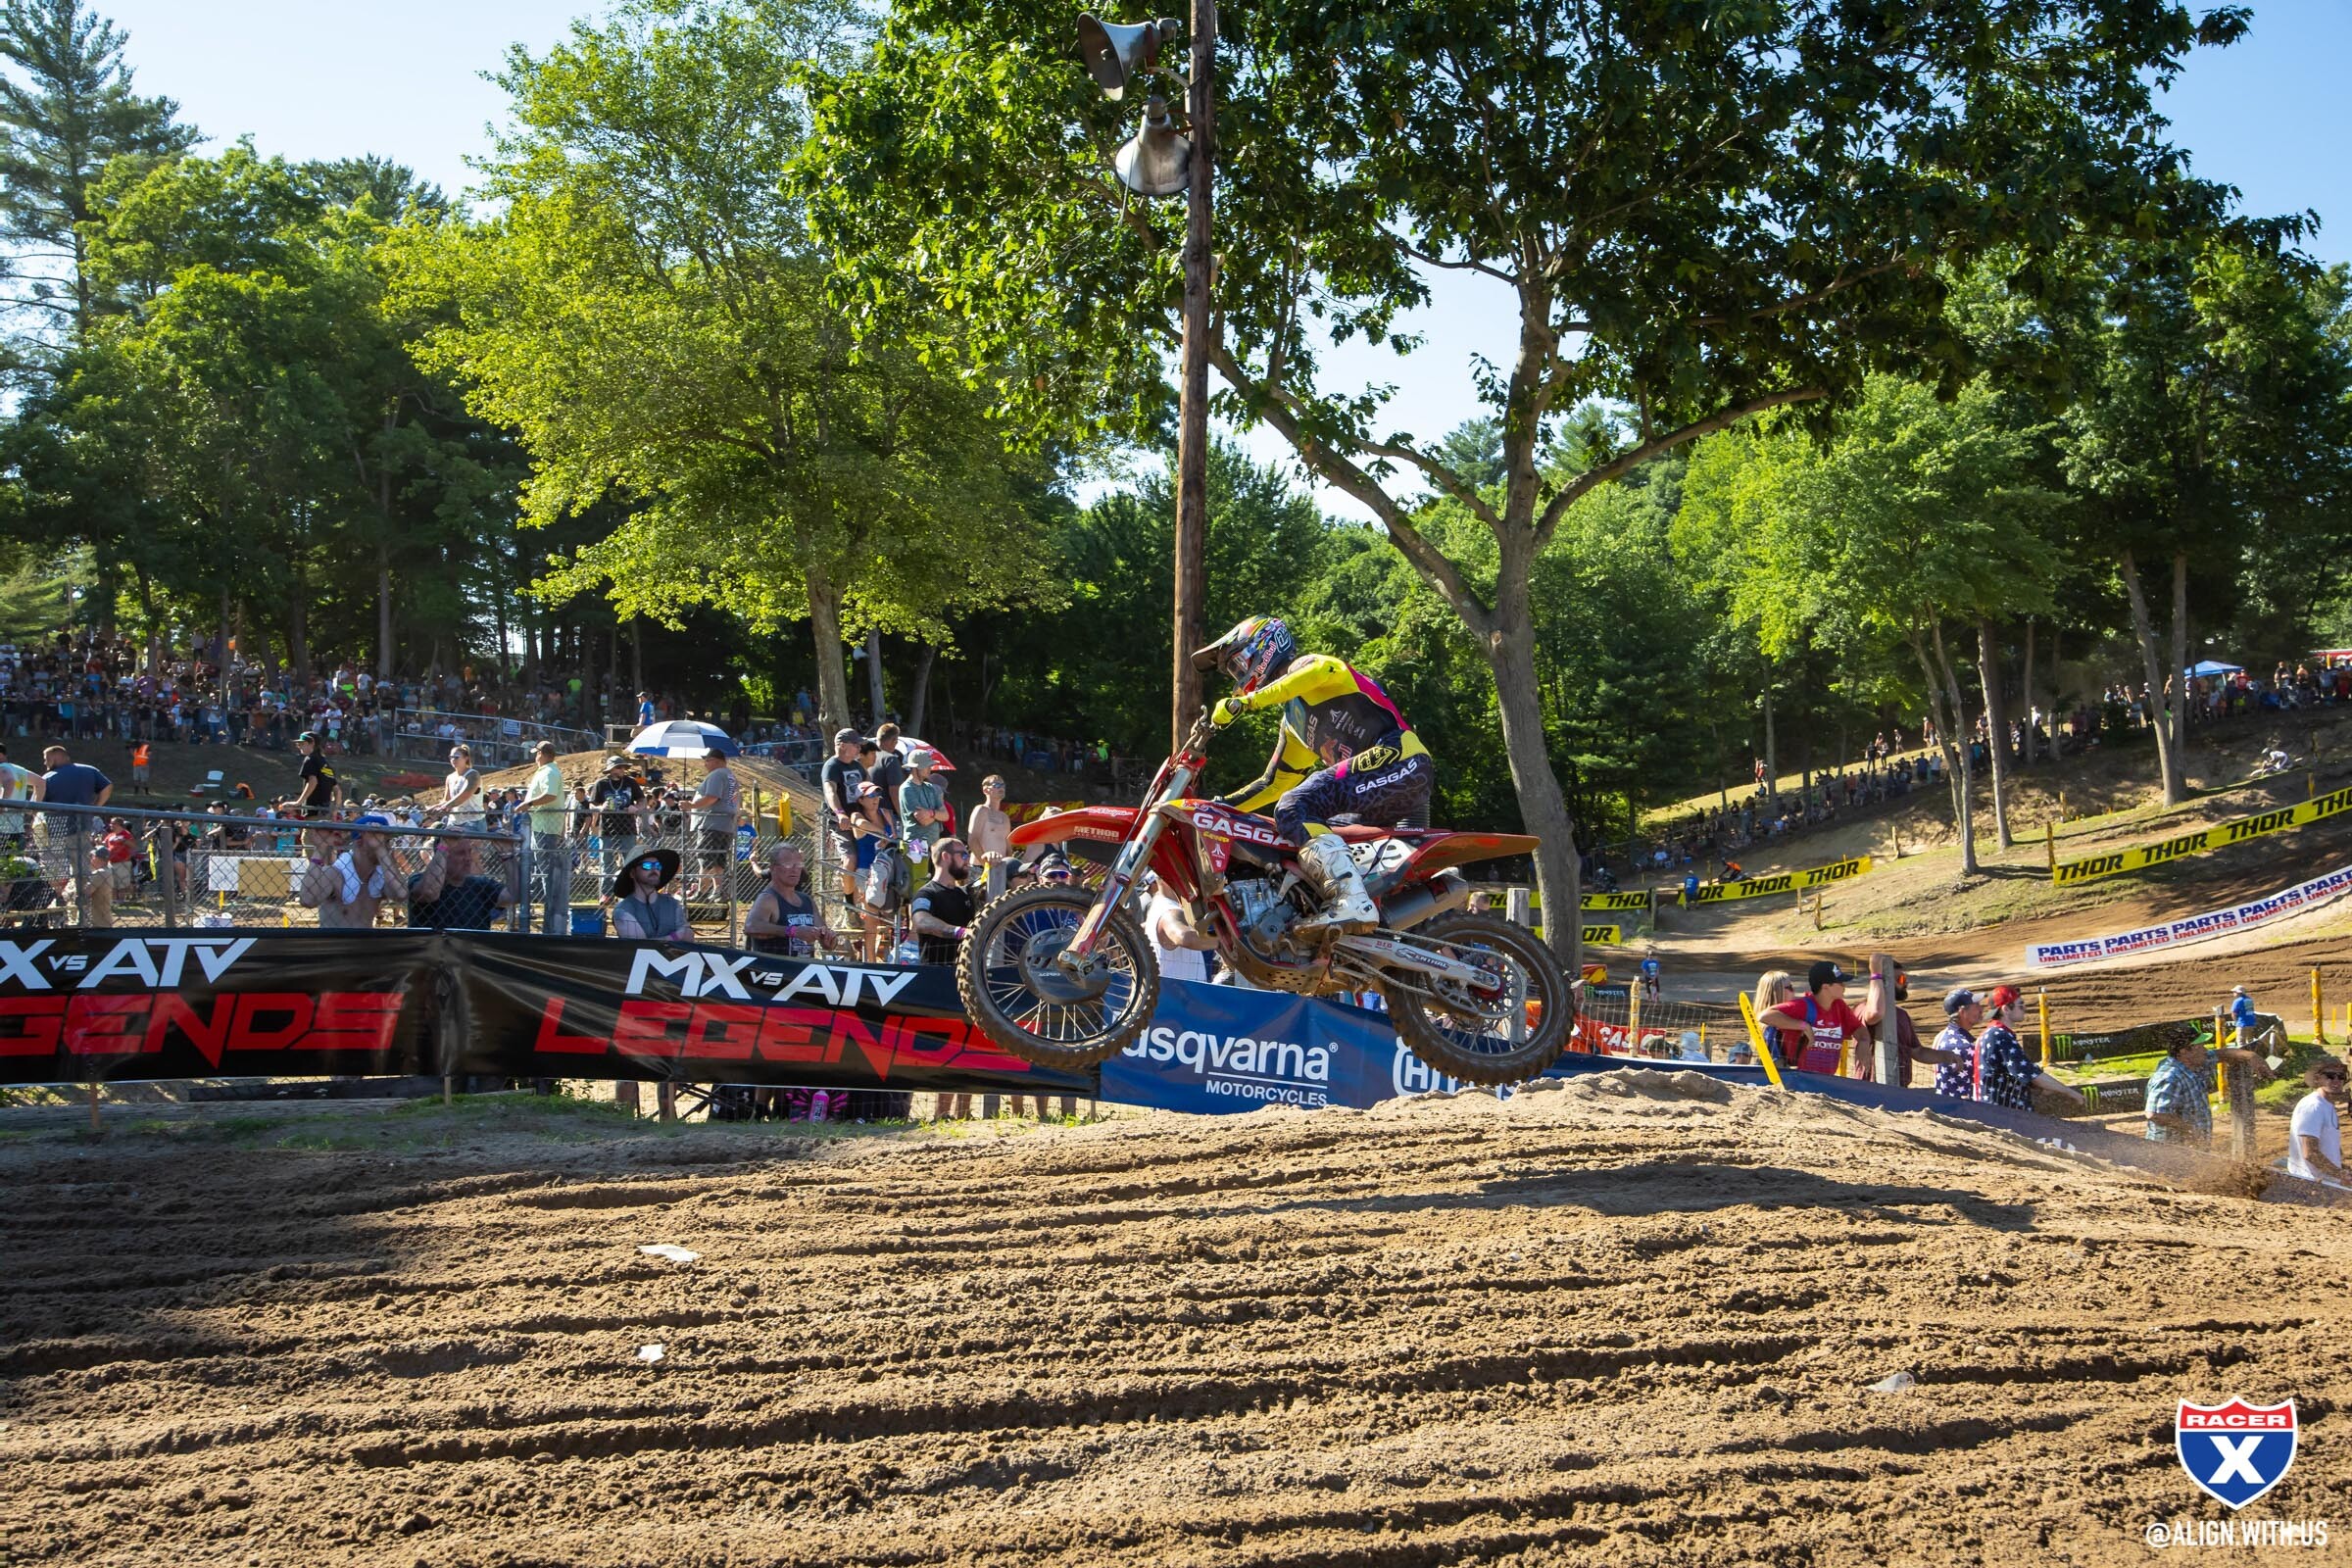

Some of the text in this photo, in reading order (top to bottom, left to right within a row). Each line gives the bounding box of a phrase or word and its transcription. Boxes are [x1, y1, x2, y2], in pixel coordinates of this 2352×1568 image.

[1355, 759, 1418, 794] GASGAS
[1074, 826, 1119, 838] METHOD
[1192, 812, 1298, 847] GASGA
[2228, 808, 2294, 841] THOR
[2141, 832, 2208, 863] THOR
[1806, 861, 1859, 885] THOR
[2058, 855, 2124, 881] THOR
[1740, 875, 1792, 896] THOR
[2037, 869, 2352, 957] PARTS PARTS PARTS PARTS PART
[1582, 927, 1613, 943] OR
[2038, 950, 2103, 963] UNLIMITED
[2106, 936, 2170, 955] UNLIMITED
[2174, 920, 2238, 940] UNLIMITED
[2241, 898, 2304, 924] UNLIMITED
[0, 939, 57, 989] X
[75, 937, 258, 989] ATV
[624, 948, 758, 1000] MX
[771, 963, 918, 1007] ATV
[0, 992, 404, 1070] GENDS
[2072, 1036, 2111, 1047] MONSTER
[1204, 1079, 1328, 1107] MOTORCYCLES
[2099, 1087, 2139, 1098] MONSTER
